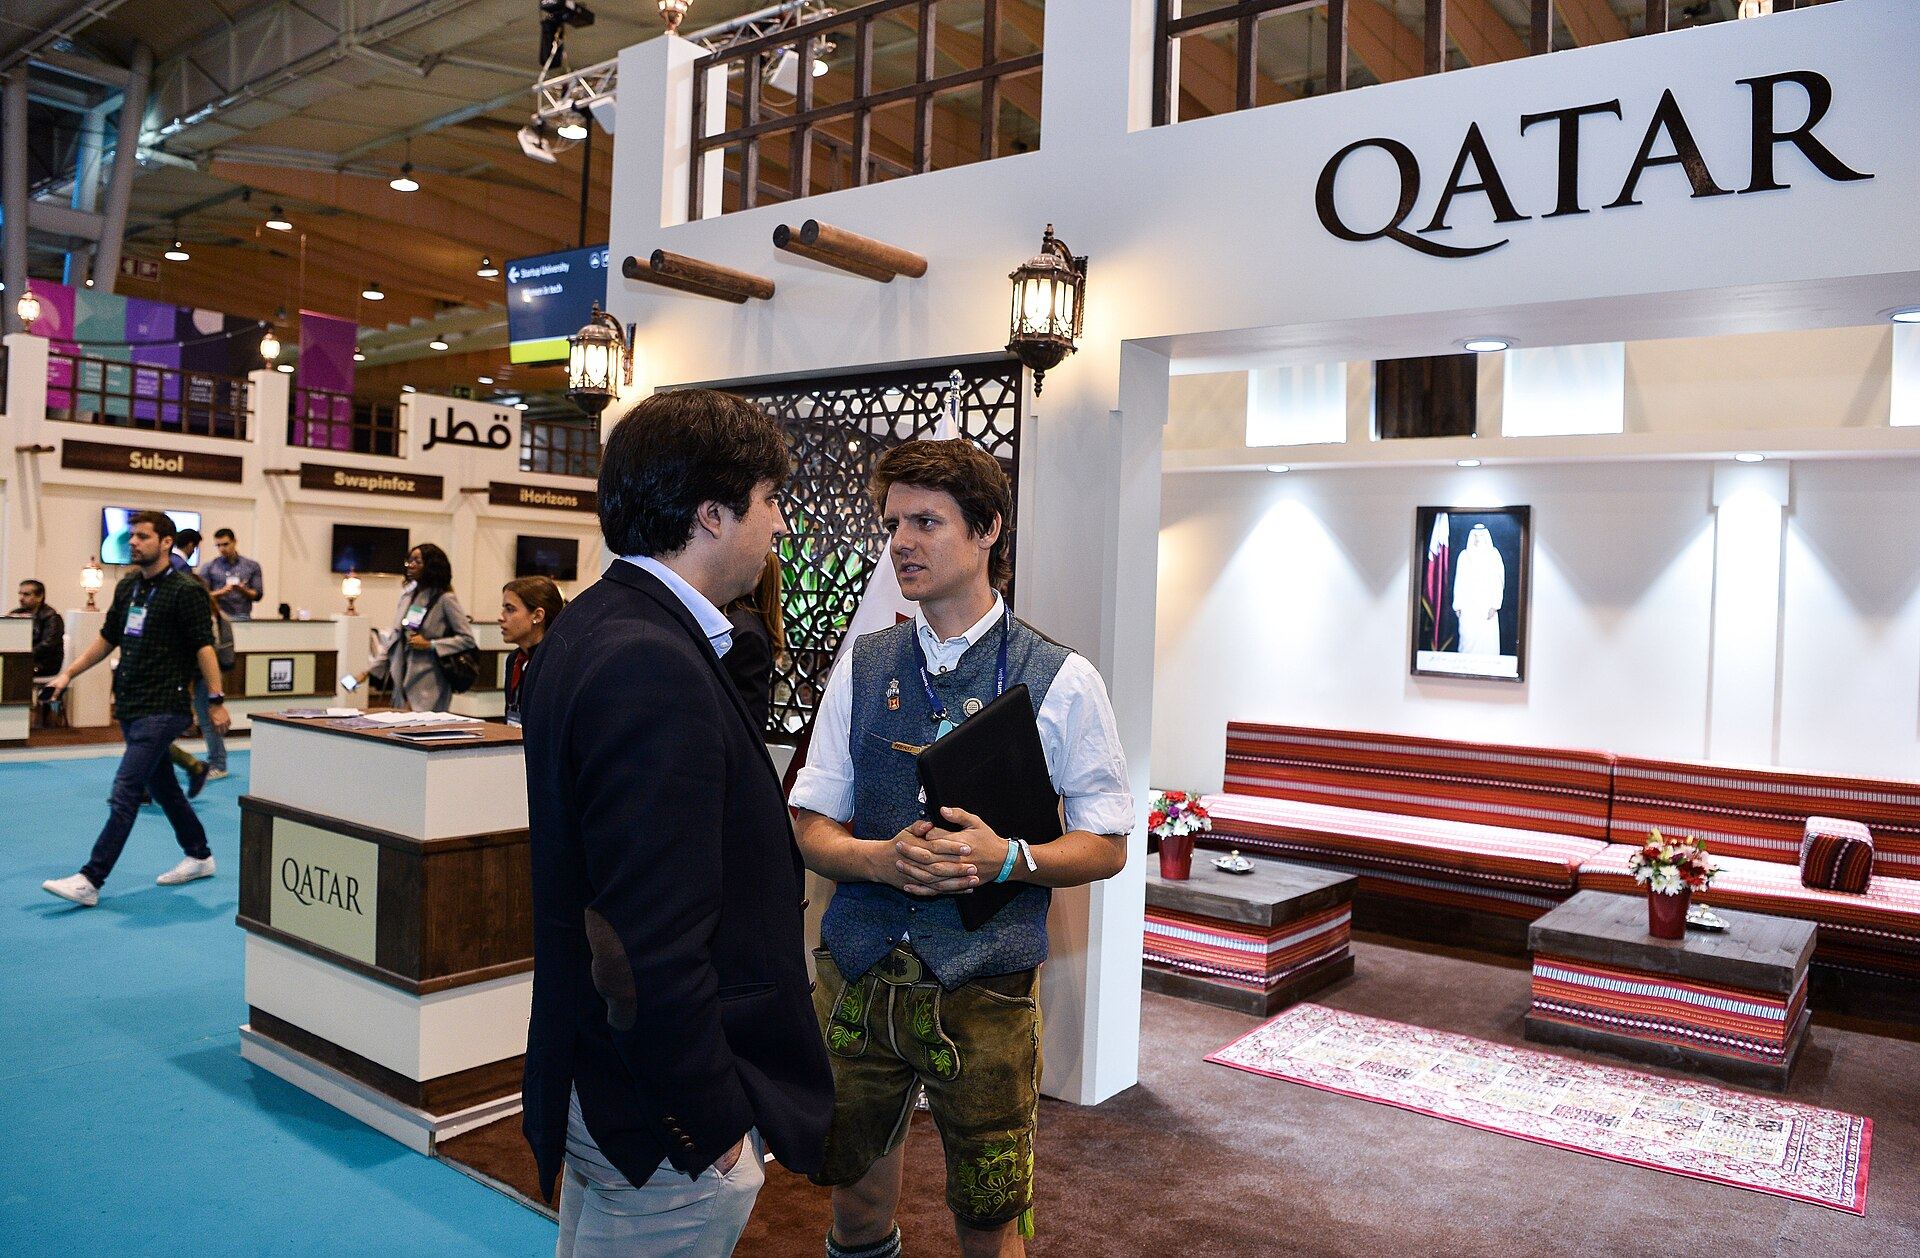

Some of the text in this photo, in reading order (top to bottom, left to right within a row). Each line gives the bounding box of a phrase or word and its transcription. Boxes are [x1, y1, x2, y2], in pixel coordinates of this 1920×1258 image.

[1315, 70, 1875, 258] QATAR
[423, 407, 511, 450] قطر
[129, 452, 184, 473] Subol
[333, 471, 416, 493] Swapinfoz
[519, 488, 578, 507] iHorizons
[282, 858, 364, 916] QATAR
